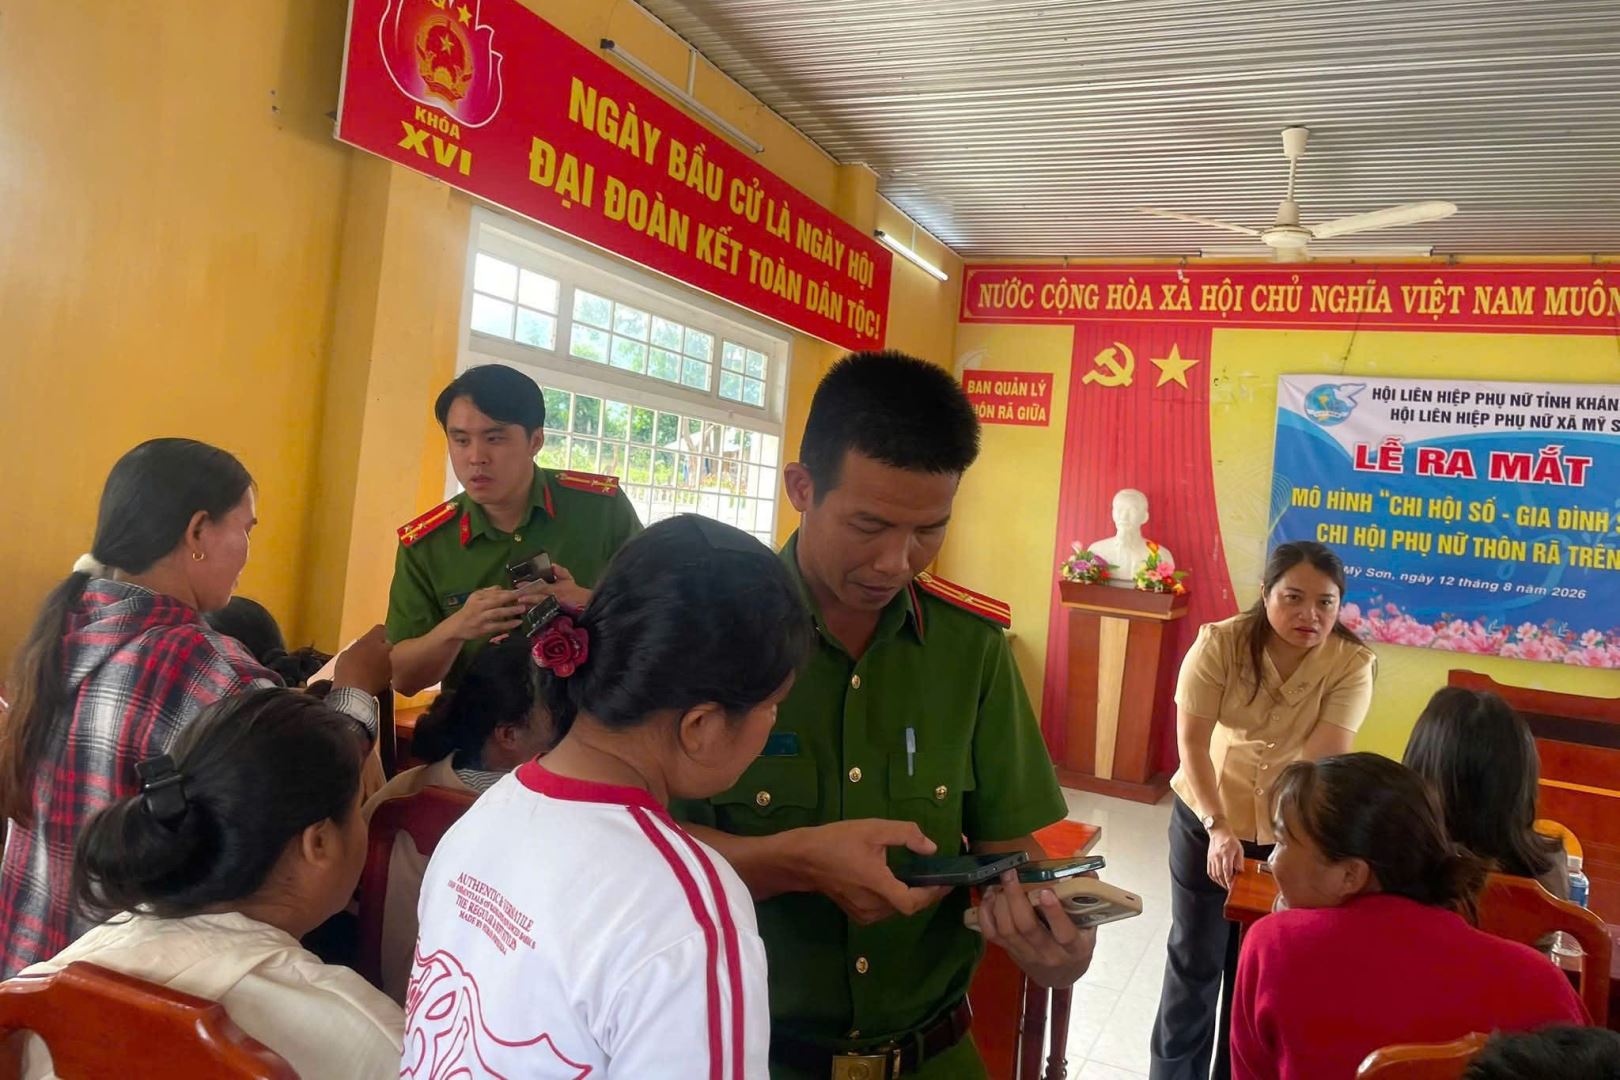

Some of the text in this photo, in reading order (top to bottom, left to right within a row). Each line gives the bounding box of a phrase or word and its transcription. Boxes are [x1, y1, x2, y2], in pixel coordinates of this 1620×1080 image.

[415, 105, 460, 140] KHÓA
[398, 120, 472, 176] XVI
[569, 76, 874, 290] NGÀY BẦU CỬ LÀ NGÀY HỘI
[529, 136, 881, 340] ĐẠI ĐOÀN KẾT TOÀN DÂN TỘC!
[978, 274, 1620, 320] NƯỚC CỘNG HÒA XÃ HỘI CHỦ NGHĨA VIỆT NAM MUÔN
[967, 376, 1046, 397] BAN QUẢN LÝ
[1372, 385, 1396, 402] HỘI
[1401, 387, 1432, 403] LIÊN
[1437, 388, 1470, 406] HIỆP
[1475, 392, 1505, 409] PHỤ
[1511, 392, 1533, 407] NỮ
[1536, 391, 1571, 409] TỈNH
[998, 402, 1014, 419] RÃ
[1017, 403, 1046, 421] GIỮA
[1390, 406, 1414, 422] HỘI
[1419, 407, 1451, 424] LIÊN
[1456, 409, 1490, 427] HIỆP
[1495, 413, 1525, 430] PHỤ
[1530, 413, 1553, 428] NỮ
[1557, 415, 1577, 430] XÃ
[1582, 416, 1606, 431] MỸ
[1354, 437, 1592, 487] LỄ RA MẮT
[1292, 485, 1321, 508] MÔ
[1326, 487, 1373, 513] HÌNH
[1428, 496, 1462, 524] HỘI
[1468, 496, 1497, 523] SỐ
[1516, 505, 1551, 528] GIA
[1557, 505, 1609, 533] ĐÌNH
[1316, 523, 1620, 570] CHI HỘI PHỤ NỮ THÔN RÃ TRÊN
[1400, 573, 1434, 585] ngày
[1439, 576, 1455, 585] 12
[1458, 577, 1499, 592] tháng
[1503, 582, 1512, 592] 8
[1516, 584, 1547, 596] năm
[1551, 587, 1587, 599] 2026
[456, 894, 468, 910] THE
[457, 871, 501, 904] AUTHENTIC
[459, 910, 476, 925] MADE
